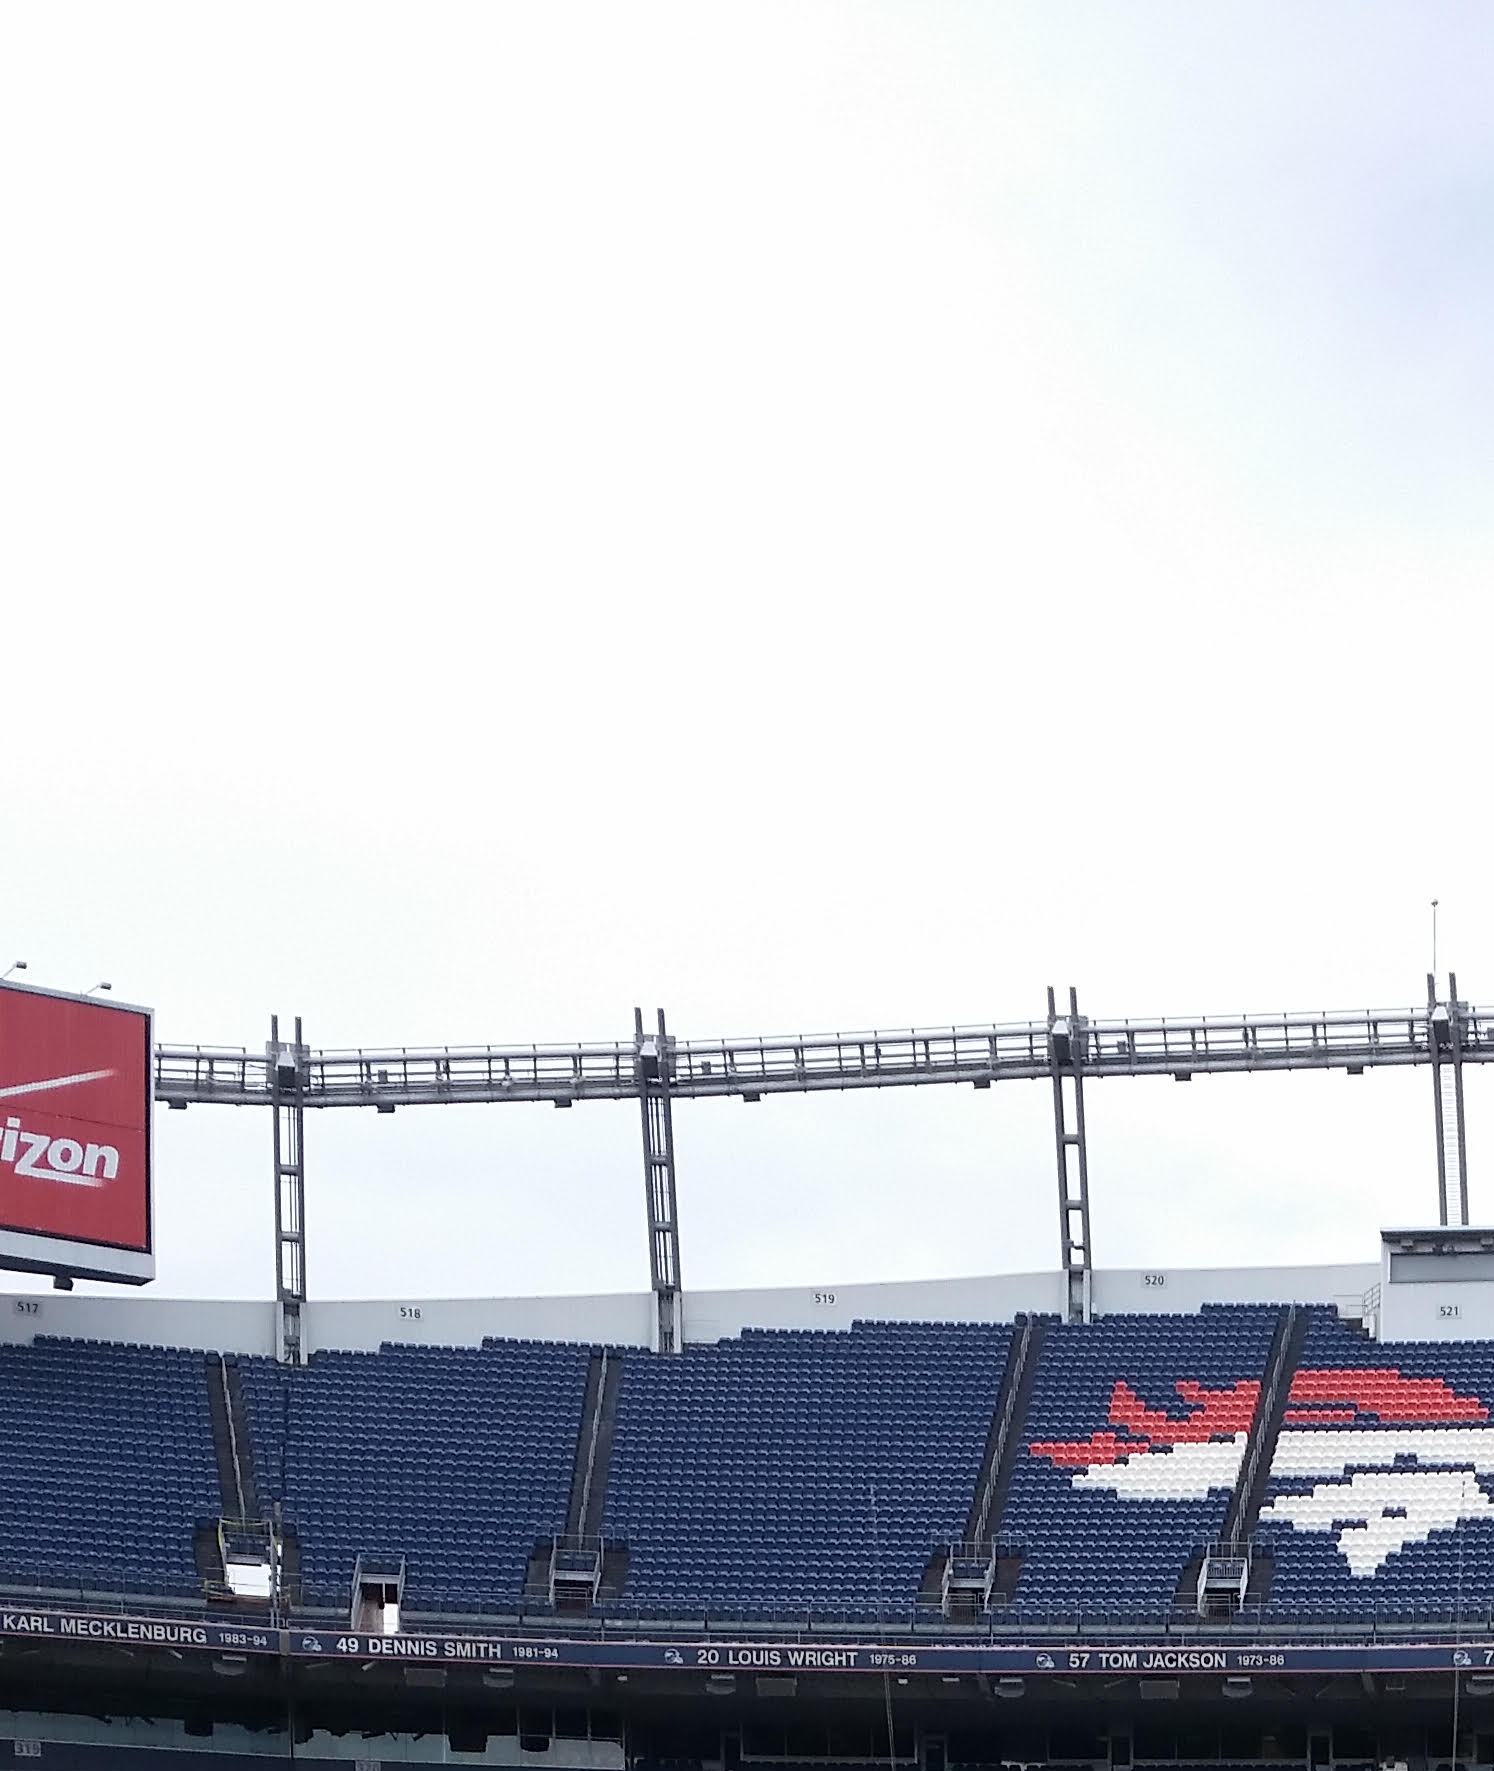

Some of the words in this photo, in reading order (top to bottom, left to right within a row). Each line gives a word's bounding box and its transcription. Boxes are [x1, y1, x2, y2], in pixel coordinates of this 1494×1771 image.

[0, 1116, 120, 1187] izon
[1144, 1274, 1165, 1286] 520
[814, 1293, 836, 1305] 519
[17, 1302, 39, 1314] 517
[399, 1307, 422, 1319] 518
[1439, 1305, 1460, 1317] 521
[2, 1614, 54, 1633] KARL
[60, 1618, 207, 1644] MECKLENBURG
[218, 1632, 268, 1647] 1983-94
[336, 1637, 359, 1654] 49
[368, 1638, 437, 1657] DENNIS
[444, 1641, 502, 1659] SMITH
[512, 1646, 559, 1659] 1981-94
[697, 1649, 719, 1665] 20
[728, 1649, 781, 1665] LOUIS
[787, 1650, 859, 1667] WRIGHT
[869, 1653, 917, 1666] 1975-86
[1068, 1653, 1090, 1668] 57
[1098, 1653, 1138, 1668] TOM
[1142, 1653, 1227, 1668] JACKSON
[1237, 1655, 1285, 1667] 1973-86
[1483, 1650, 1494, 1665] 7
